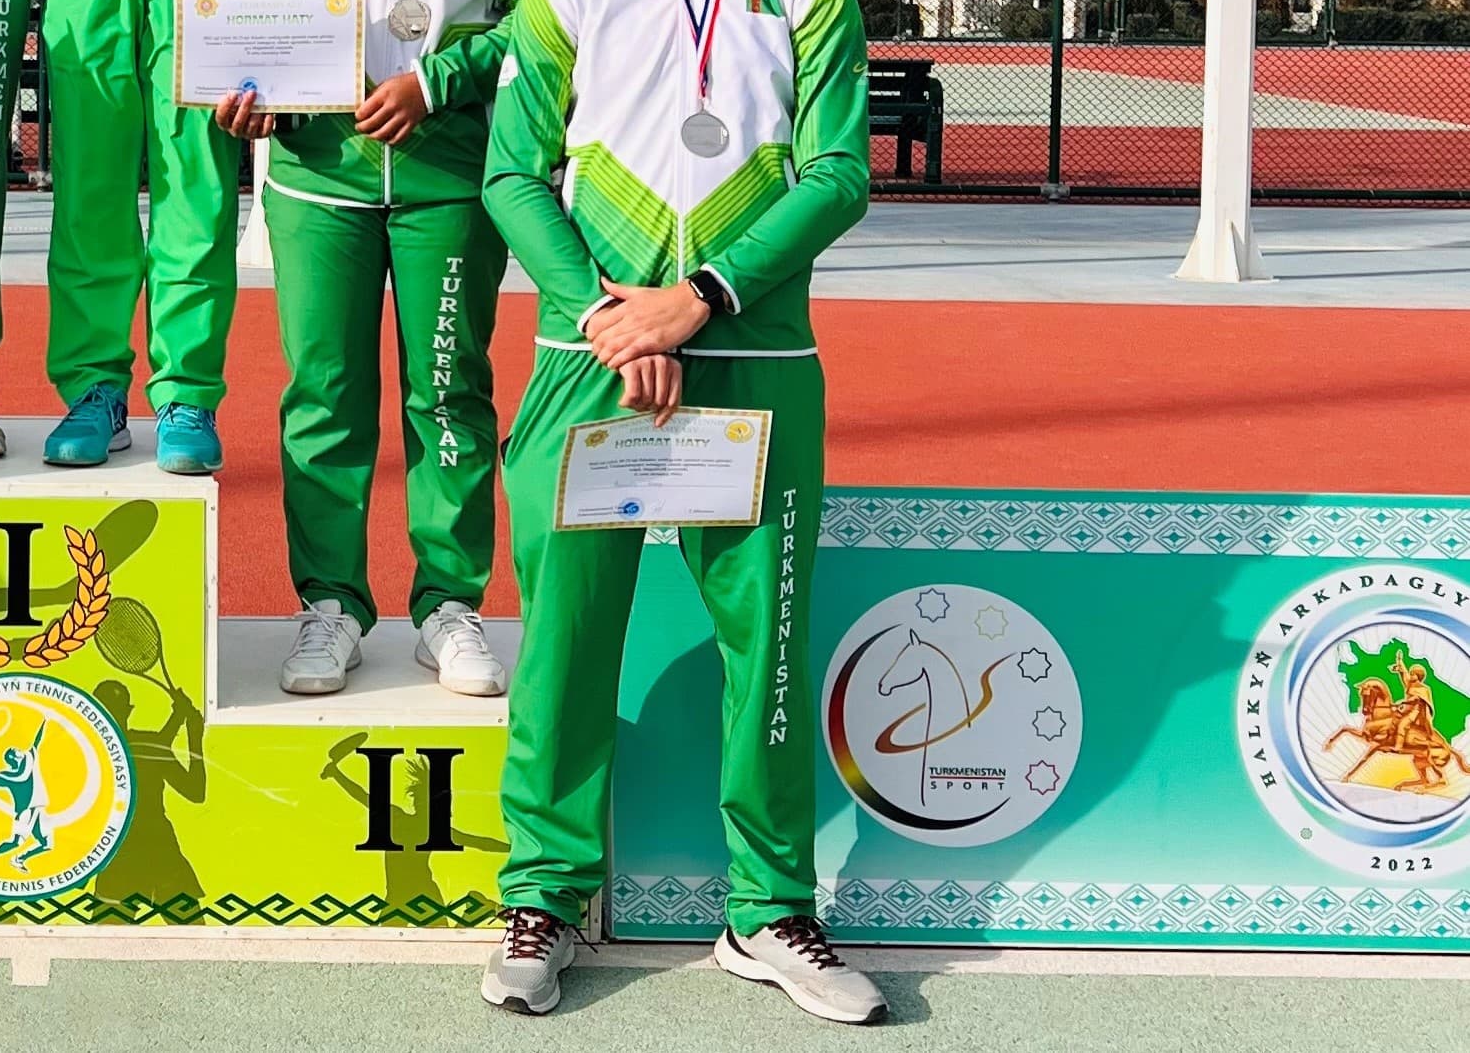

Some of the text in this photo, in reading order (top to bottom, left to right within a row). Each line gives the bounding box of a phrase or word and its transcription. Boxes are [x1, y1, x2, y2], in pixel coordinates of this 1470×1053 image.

[768, 487, 797, 746] TURKMENISTAN
[1278, 573, 1469, 637] ARKADAGLY
[26, 681, 75, 704] TENNIS
[929, 766, 1007, 776] TURKMENISTAN
[930, 780, 1005, 791] SPORT
[353, 747, 466, 853] II
[48, 825, 118, 888] FEDERATION
[1370, 855, 1433, 873] 2022
